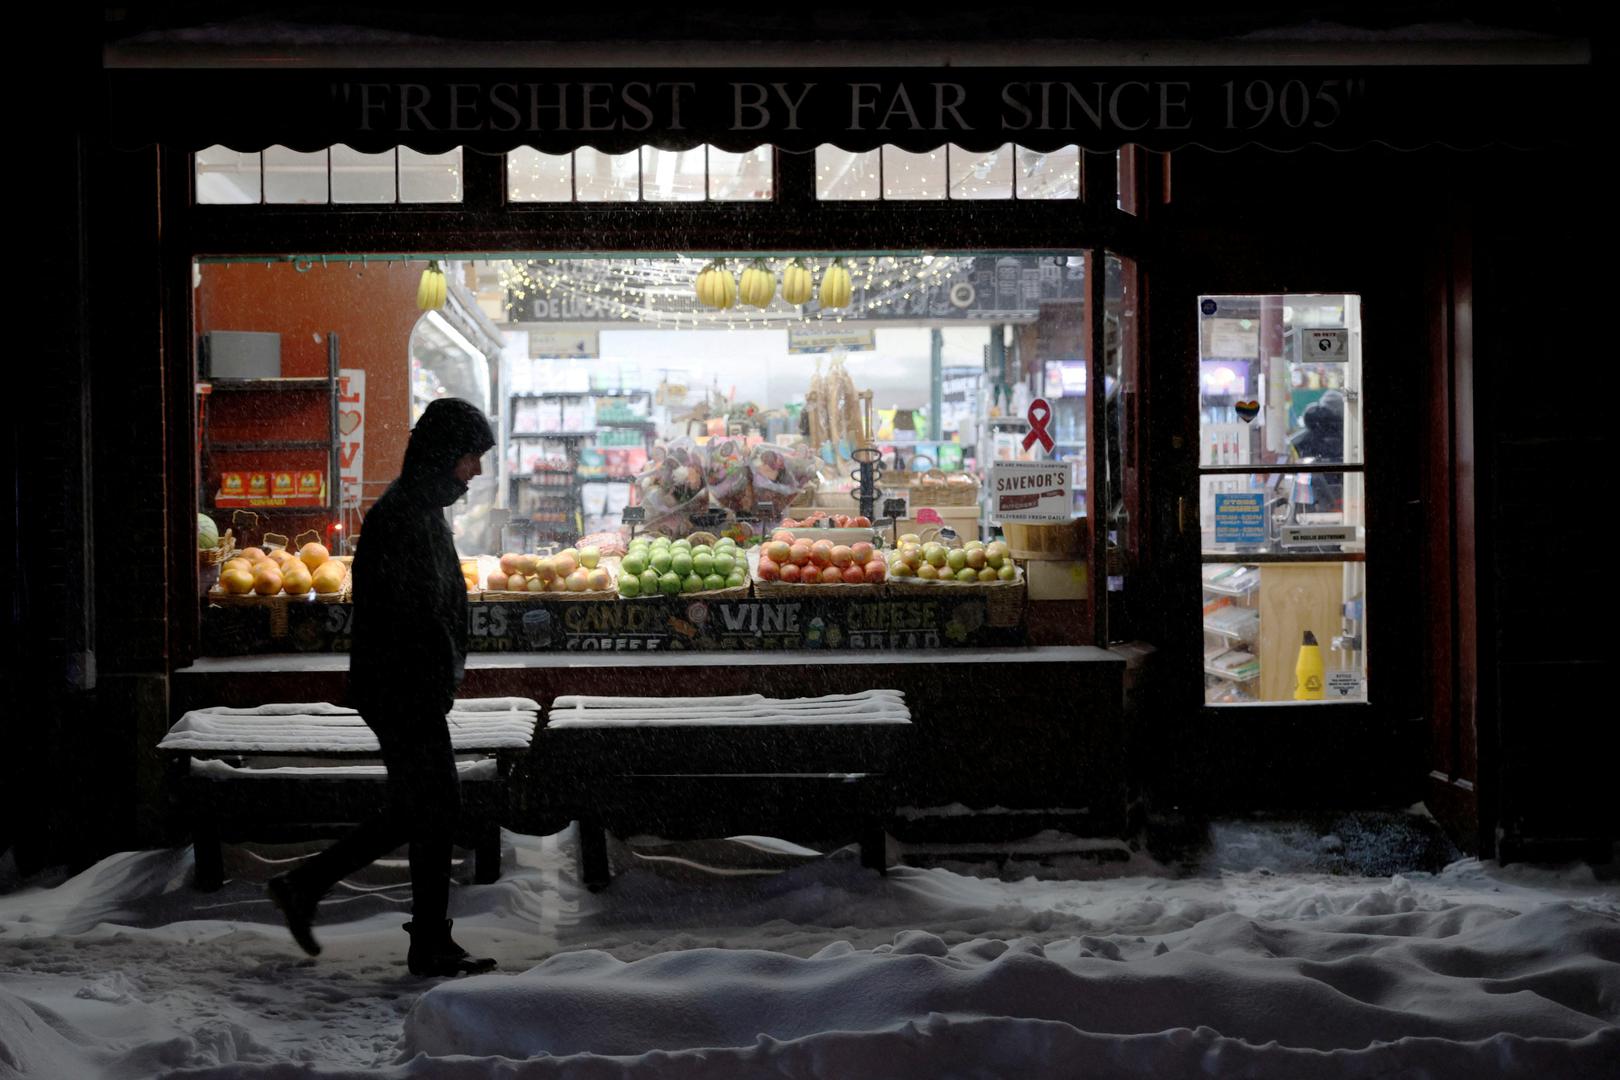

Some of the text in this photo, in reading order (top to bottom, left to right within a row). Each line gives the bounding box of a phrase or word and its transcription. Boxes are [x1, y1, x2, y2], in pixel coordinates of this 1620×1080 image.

[727, 80, 815, 132] BY
[844, 80, 976, 132] FAR
[1000, 79, 1193, 131] SINCE
[1221, 79, 1368, 131] 1905"
[997, 472, 1065, 492] SAVENOR'S
[719, 603, 801, 631] WINE
